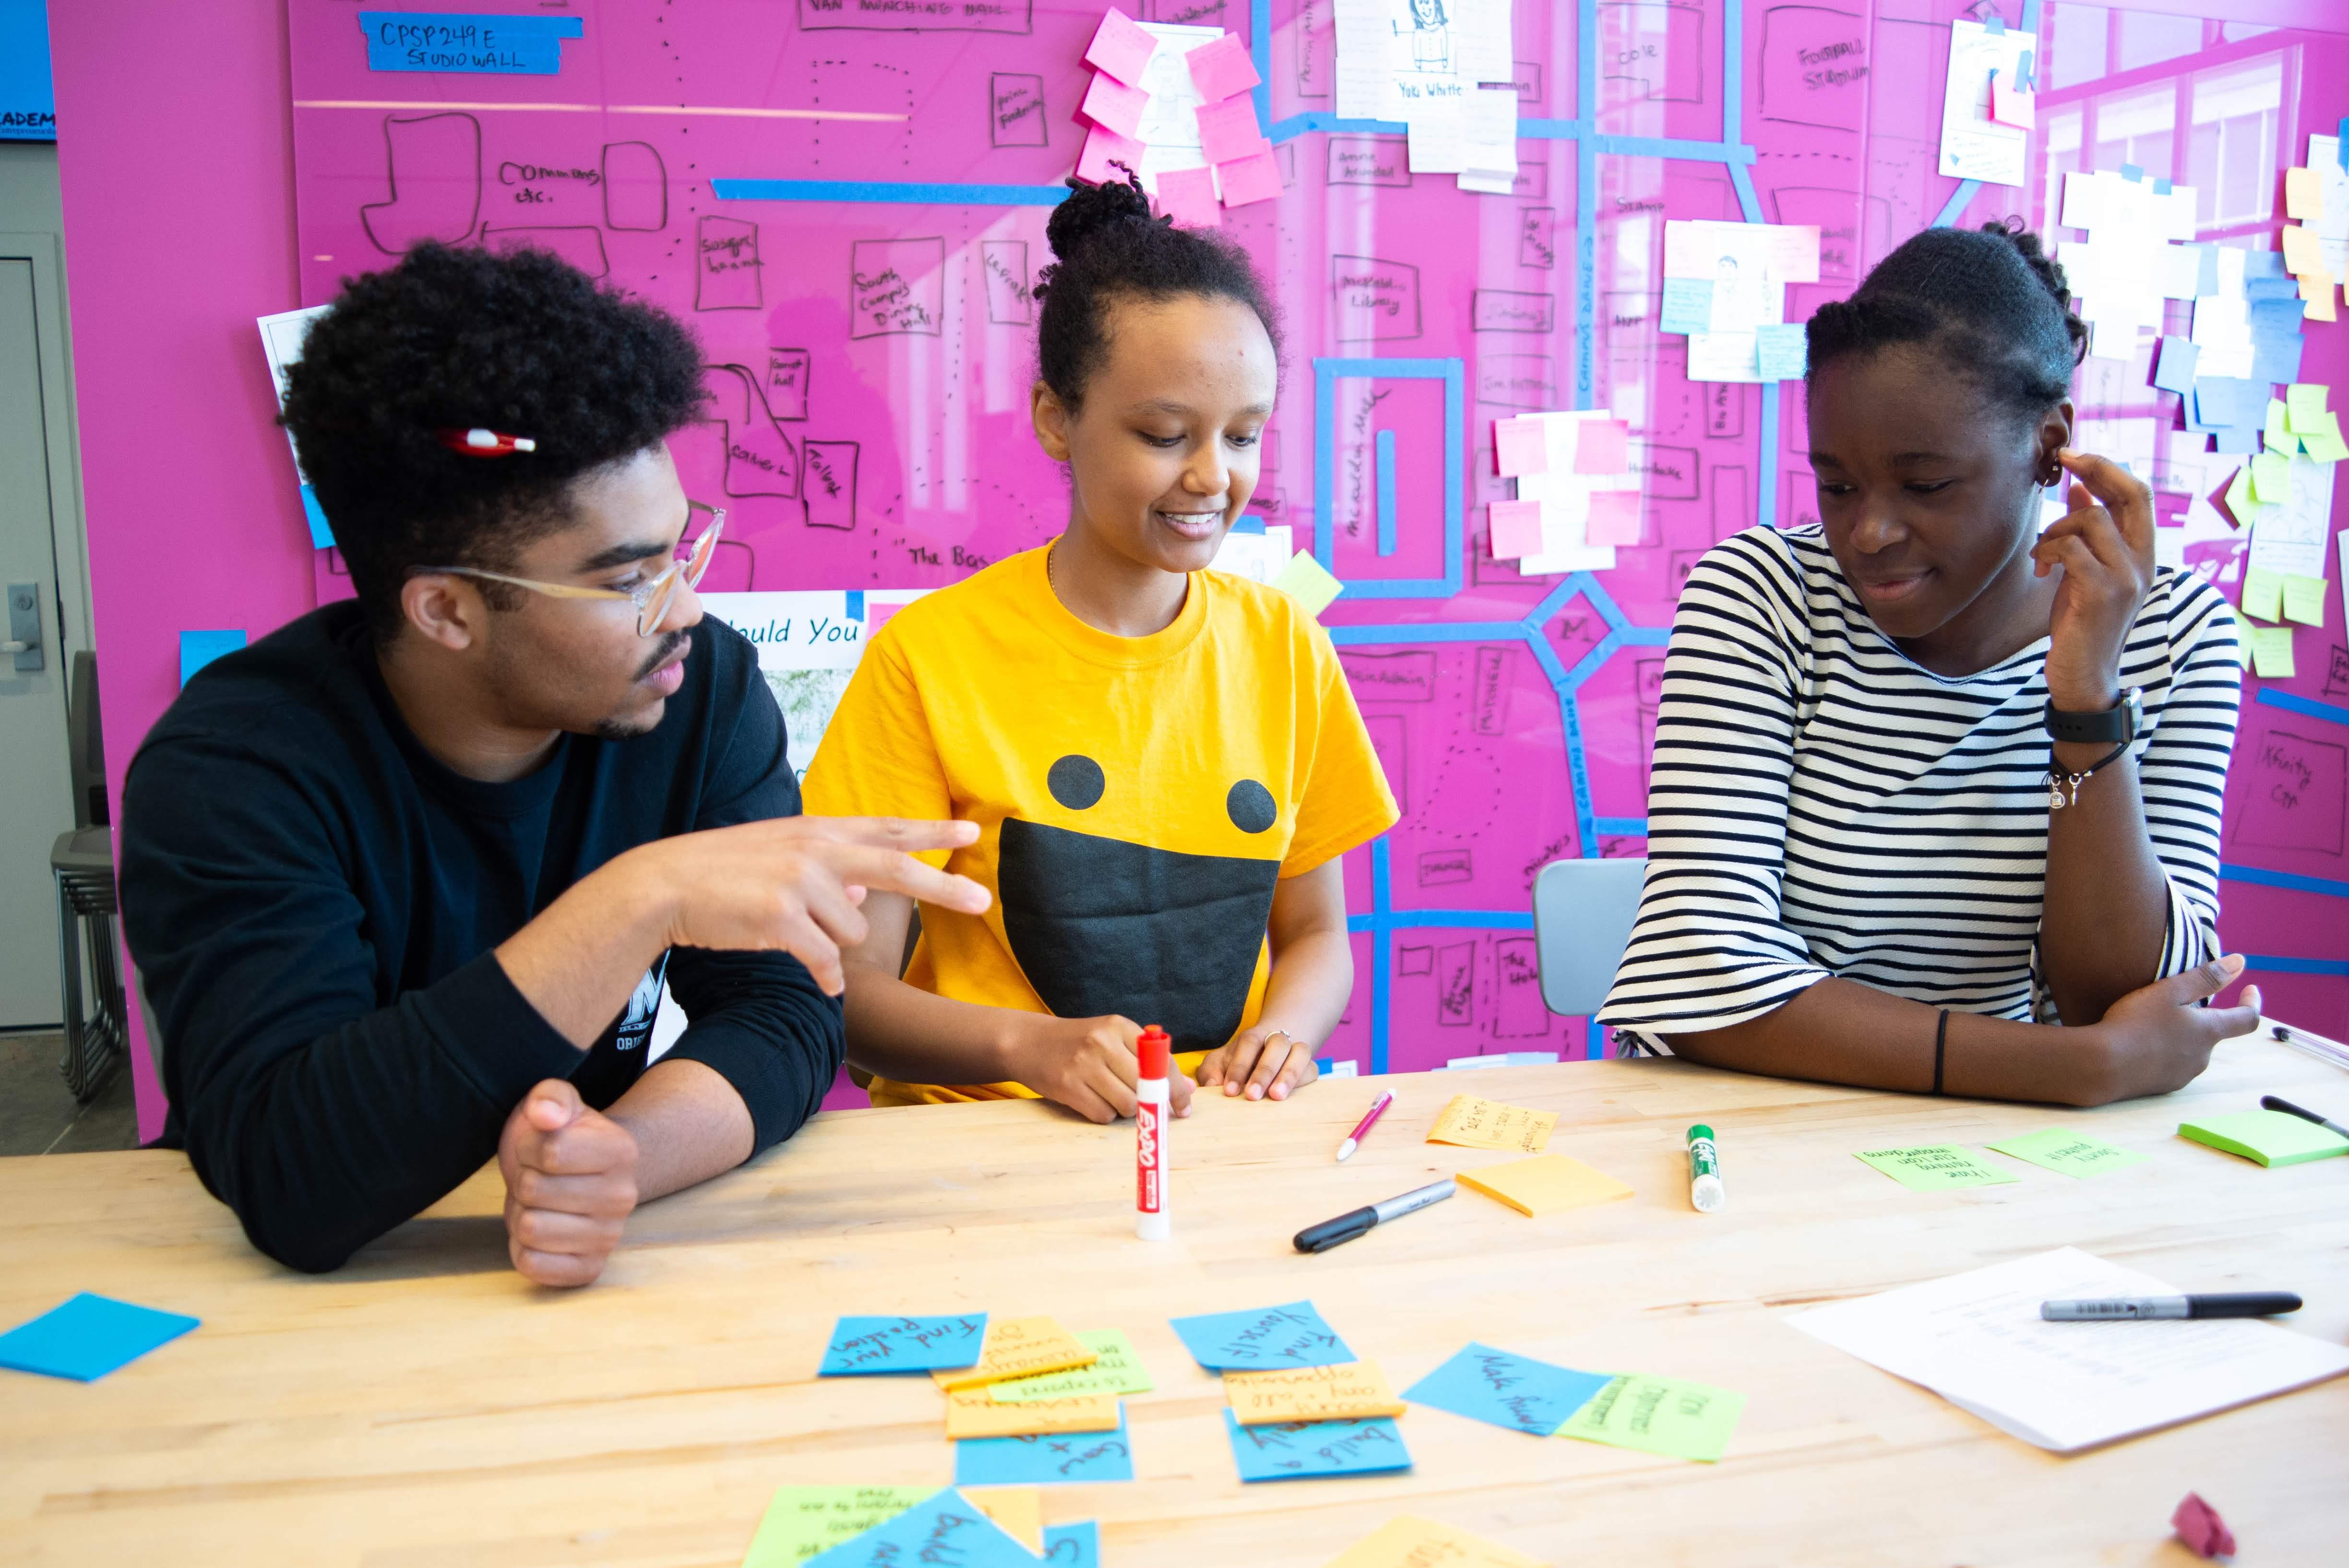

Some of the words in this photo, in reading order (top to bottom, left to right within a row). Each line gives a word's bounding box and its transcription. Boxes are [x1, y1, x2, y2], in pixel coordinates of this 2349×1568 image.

[407, 50, 468, 66] STUDIO
[472, 51, 526, 68] WALL
[0, 111, 56, 127] ADEM
[854, 271, 901, 289] South
[909, 546, 942, 566] The
[952, 545, 989, 568] Bas
[808, 617, 858, 644] You
